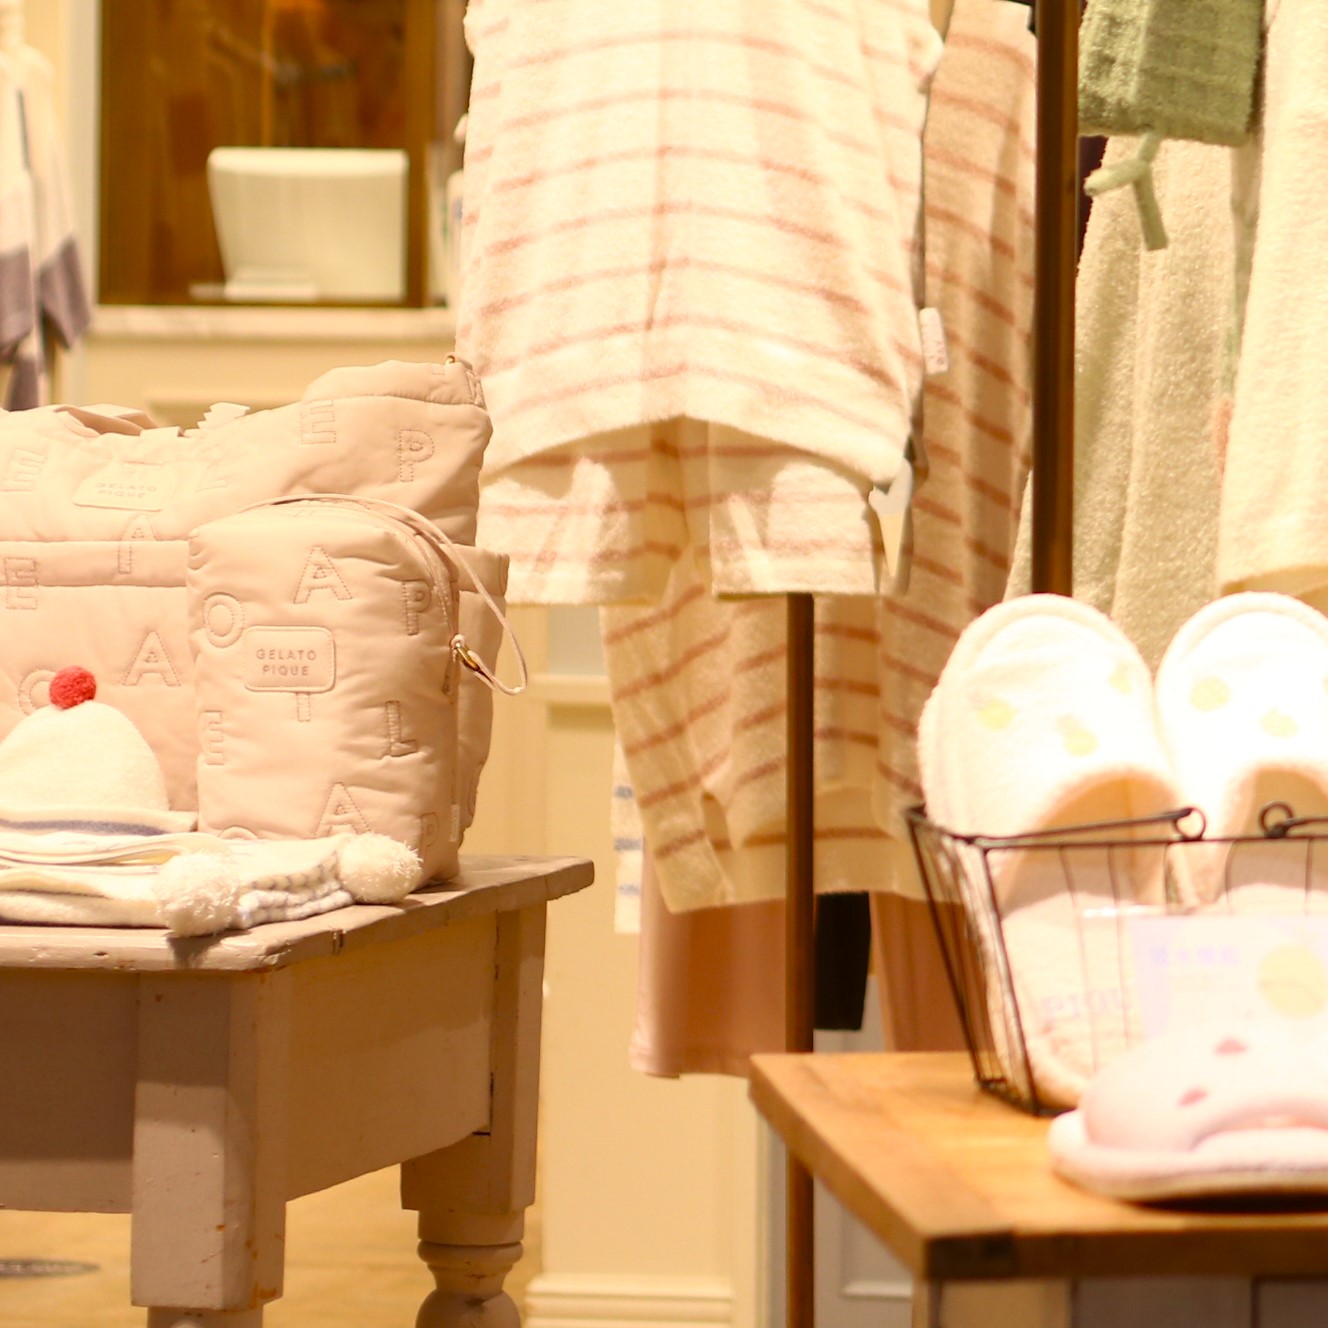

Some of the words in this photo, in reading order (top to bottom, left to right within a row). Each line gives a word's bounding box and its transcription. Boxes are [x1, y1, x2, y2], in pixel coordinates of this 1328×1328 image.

[95, 482, 158, 493] GELATO
[293, 545, 354, 604] A
[255, 648, 317, 661] GELATO
[262, 664, 309, 677] PIQUE
